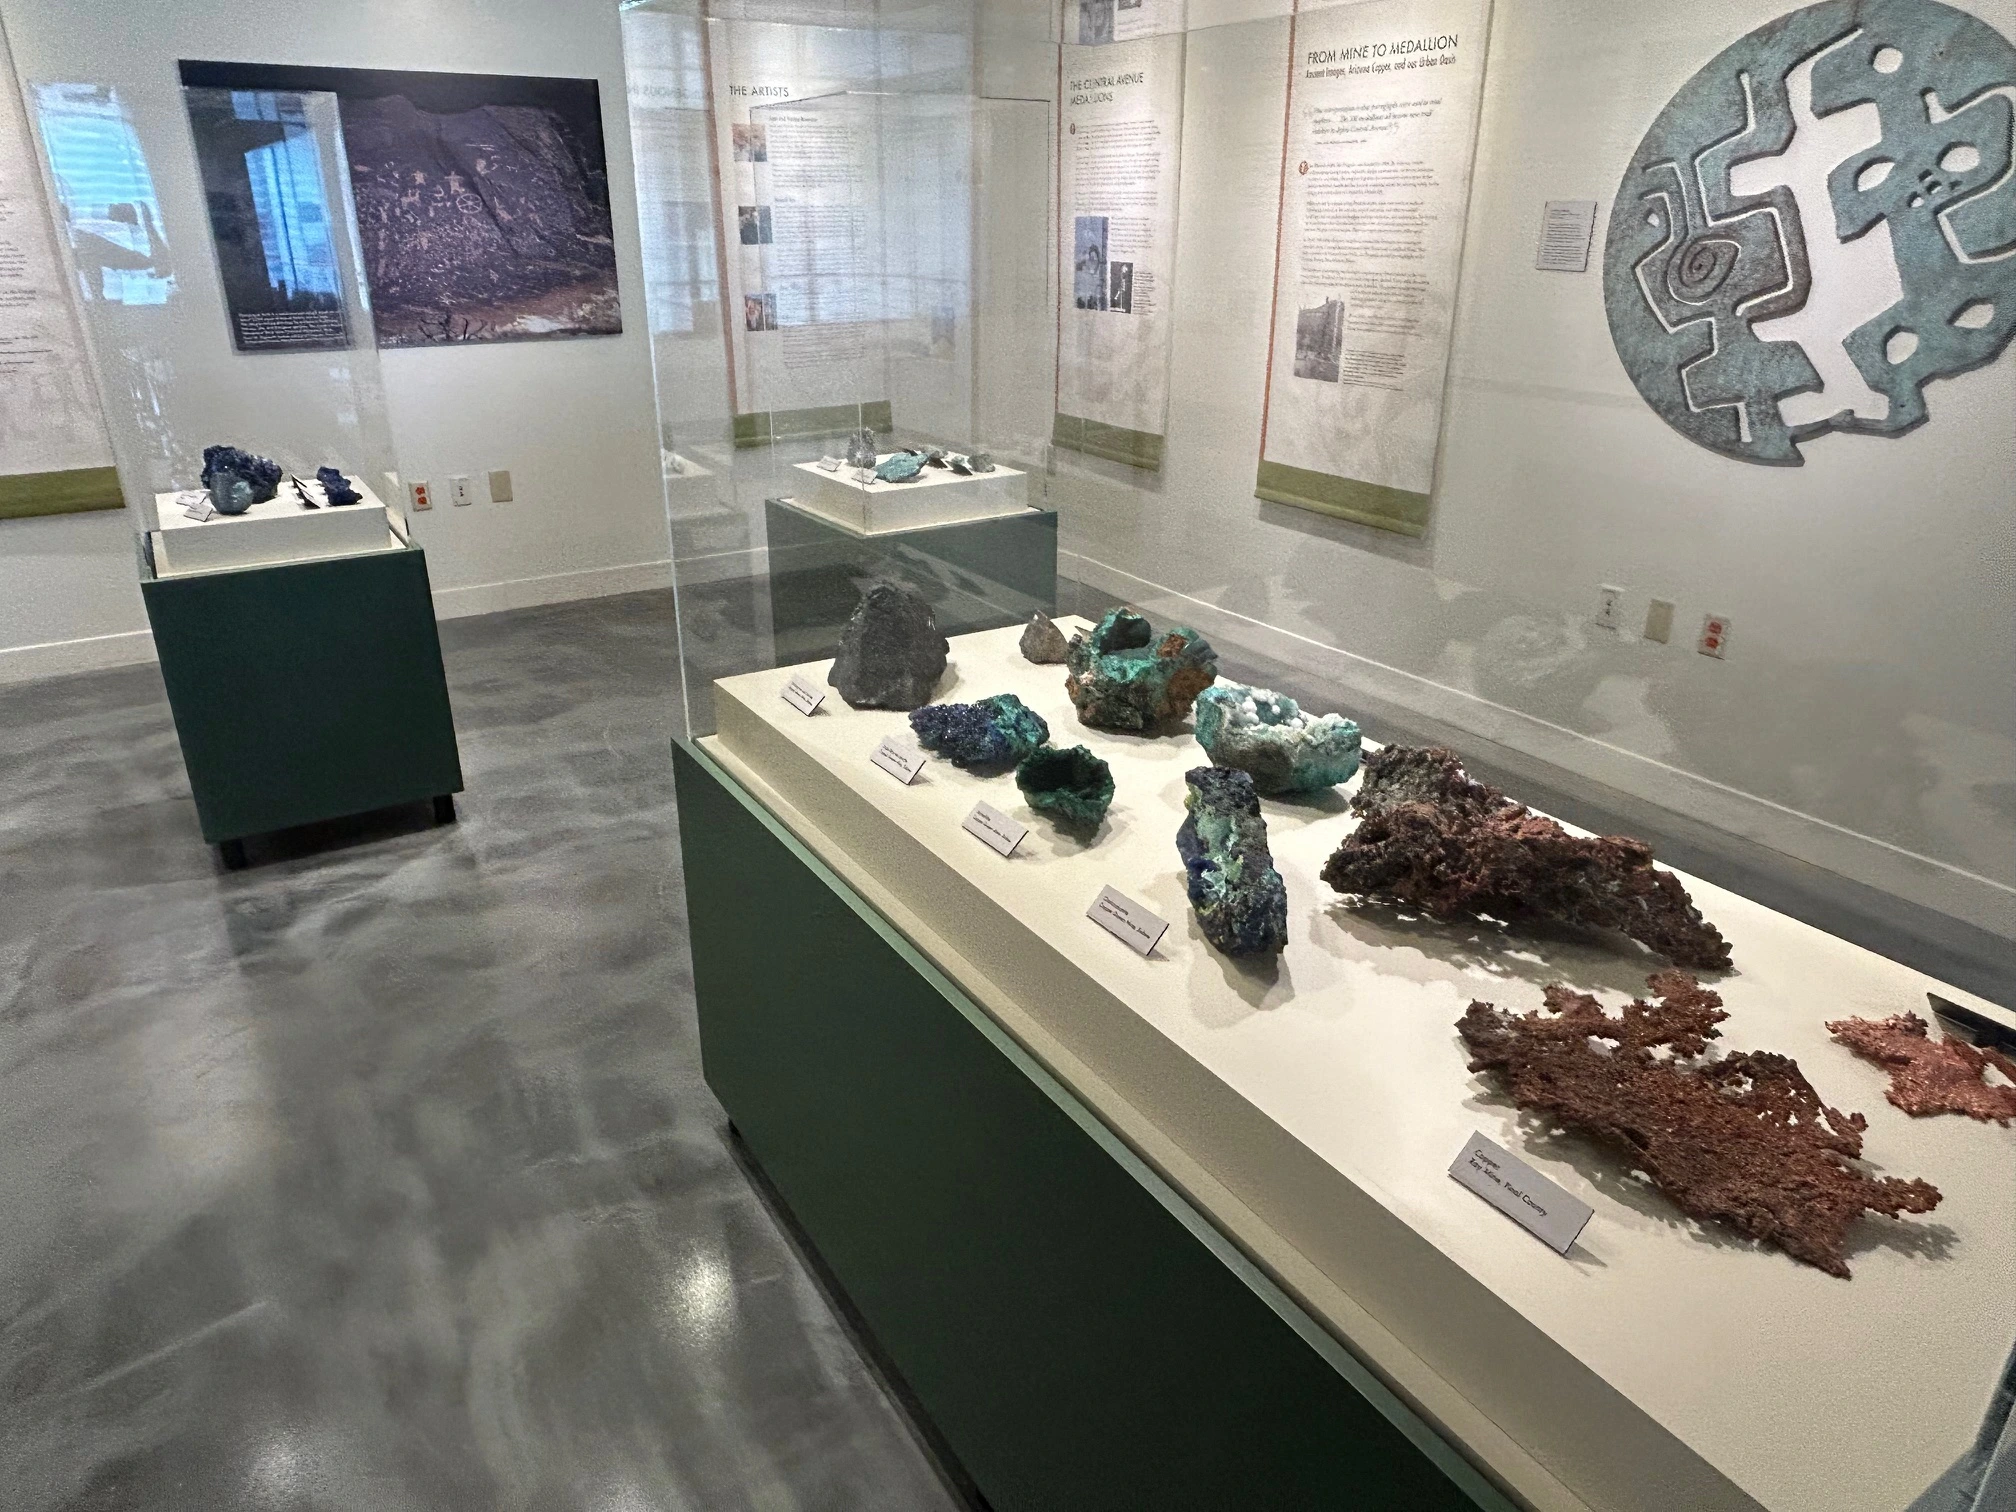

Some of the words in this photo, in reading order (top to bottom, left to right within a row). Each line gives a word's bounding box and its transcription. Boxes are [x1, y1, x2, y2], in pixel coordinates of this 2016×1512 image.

[1308, 50, 1336, 64] FROM
[1340, 45, 1369, 60] MINE
[1372, 43, 1387, 57] TO
[1389, 34, 1458, 54] MEDALLION
[729, 84, 747, 96] THE
[751, 86, 789, 97] ARTISTS
[1475, 1149, 1501, 1170] Copper
[1522, 1195, 1547, 1216] County
